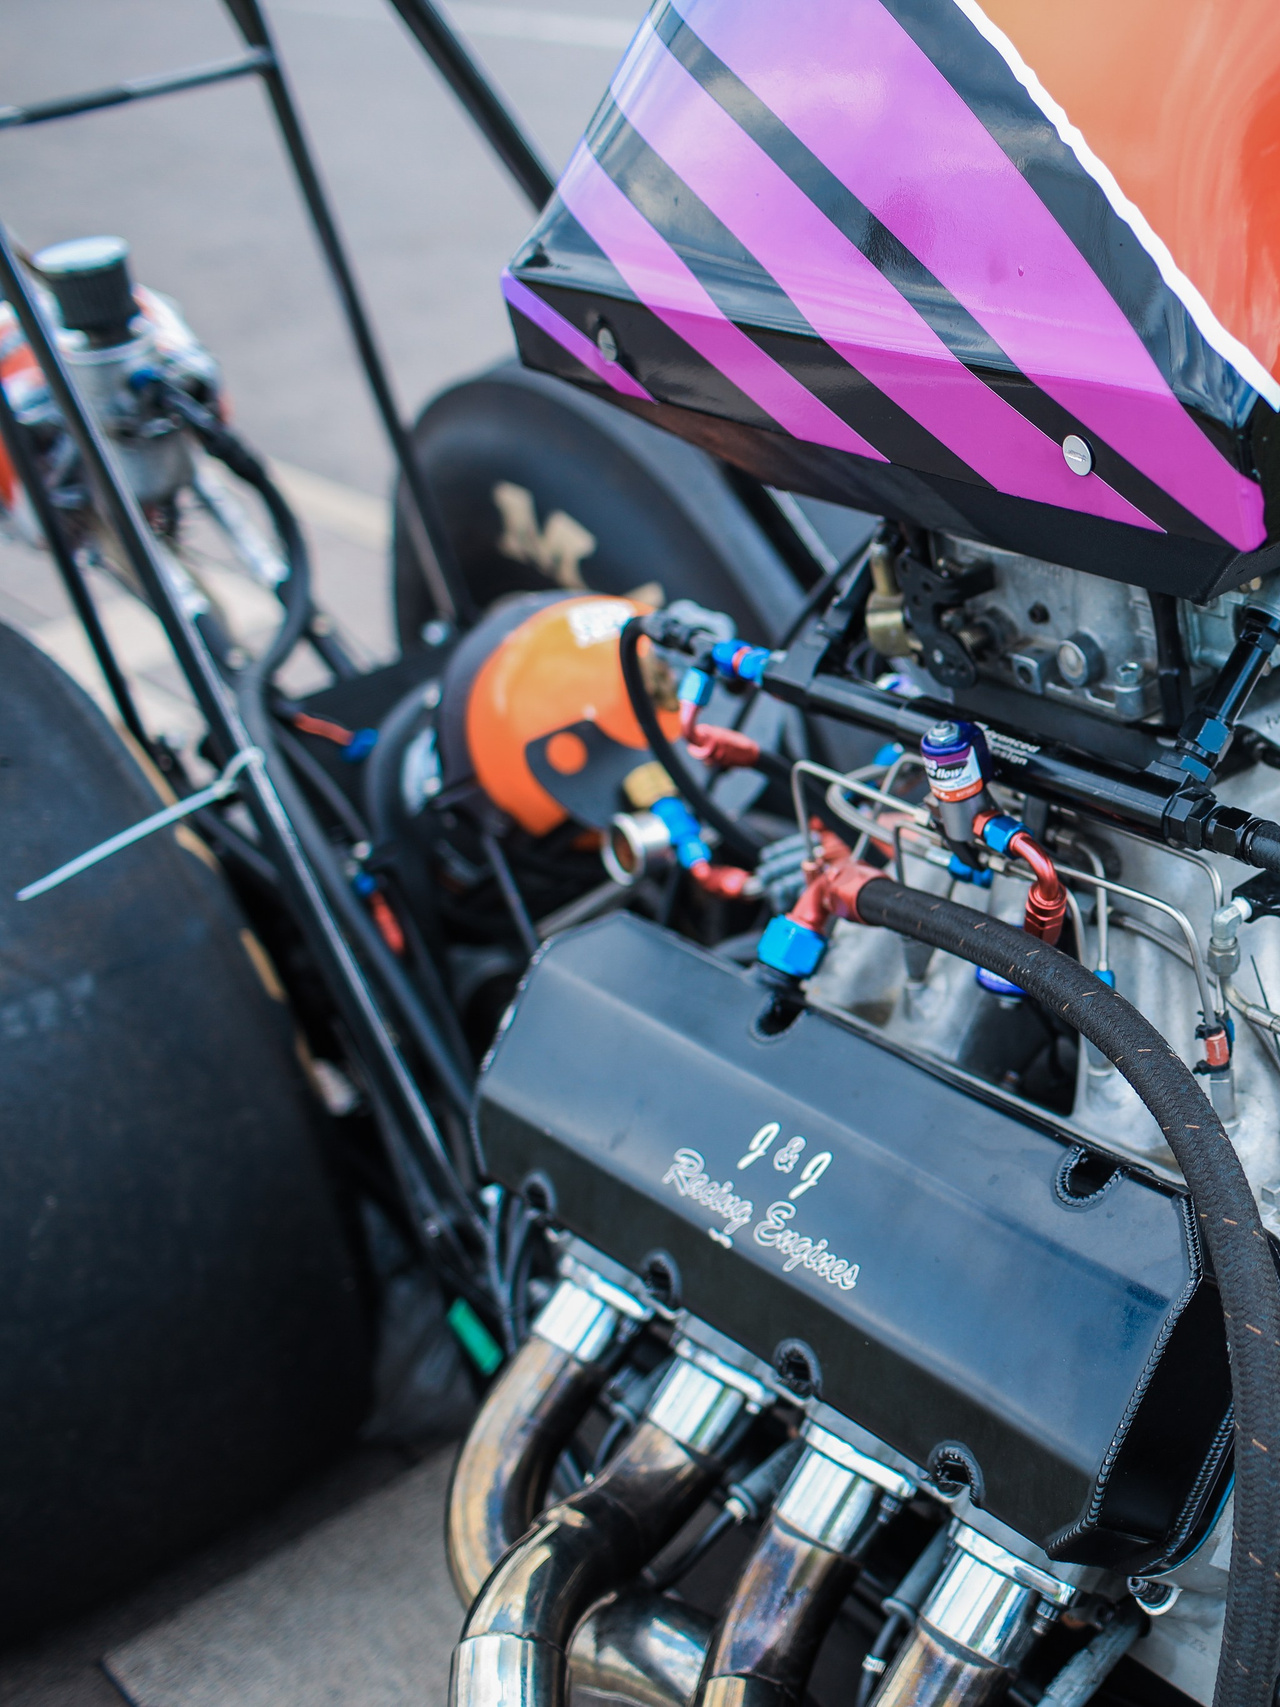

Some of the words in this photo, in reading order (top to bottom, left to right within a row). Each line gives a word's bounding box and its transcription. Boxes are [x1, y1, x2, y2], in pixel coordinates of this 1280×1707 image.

[773, 1136, 807, 1173] &
[662, 1148, 753, 1235] Racing
[753, 1200, 861, 1291] Engines
